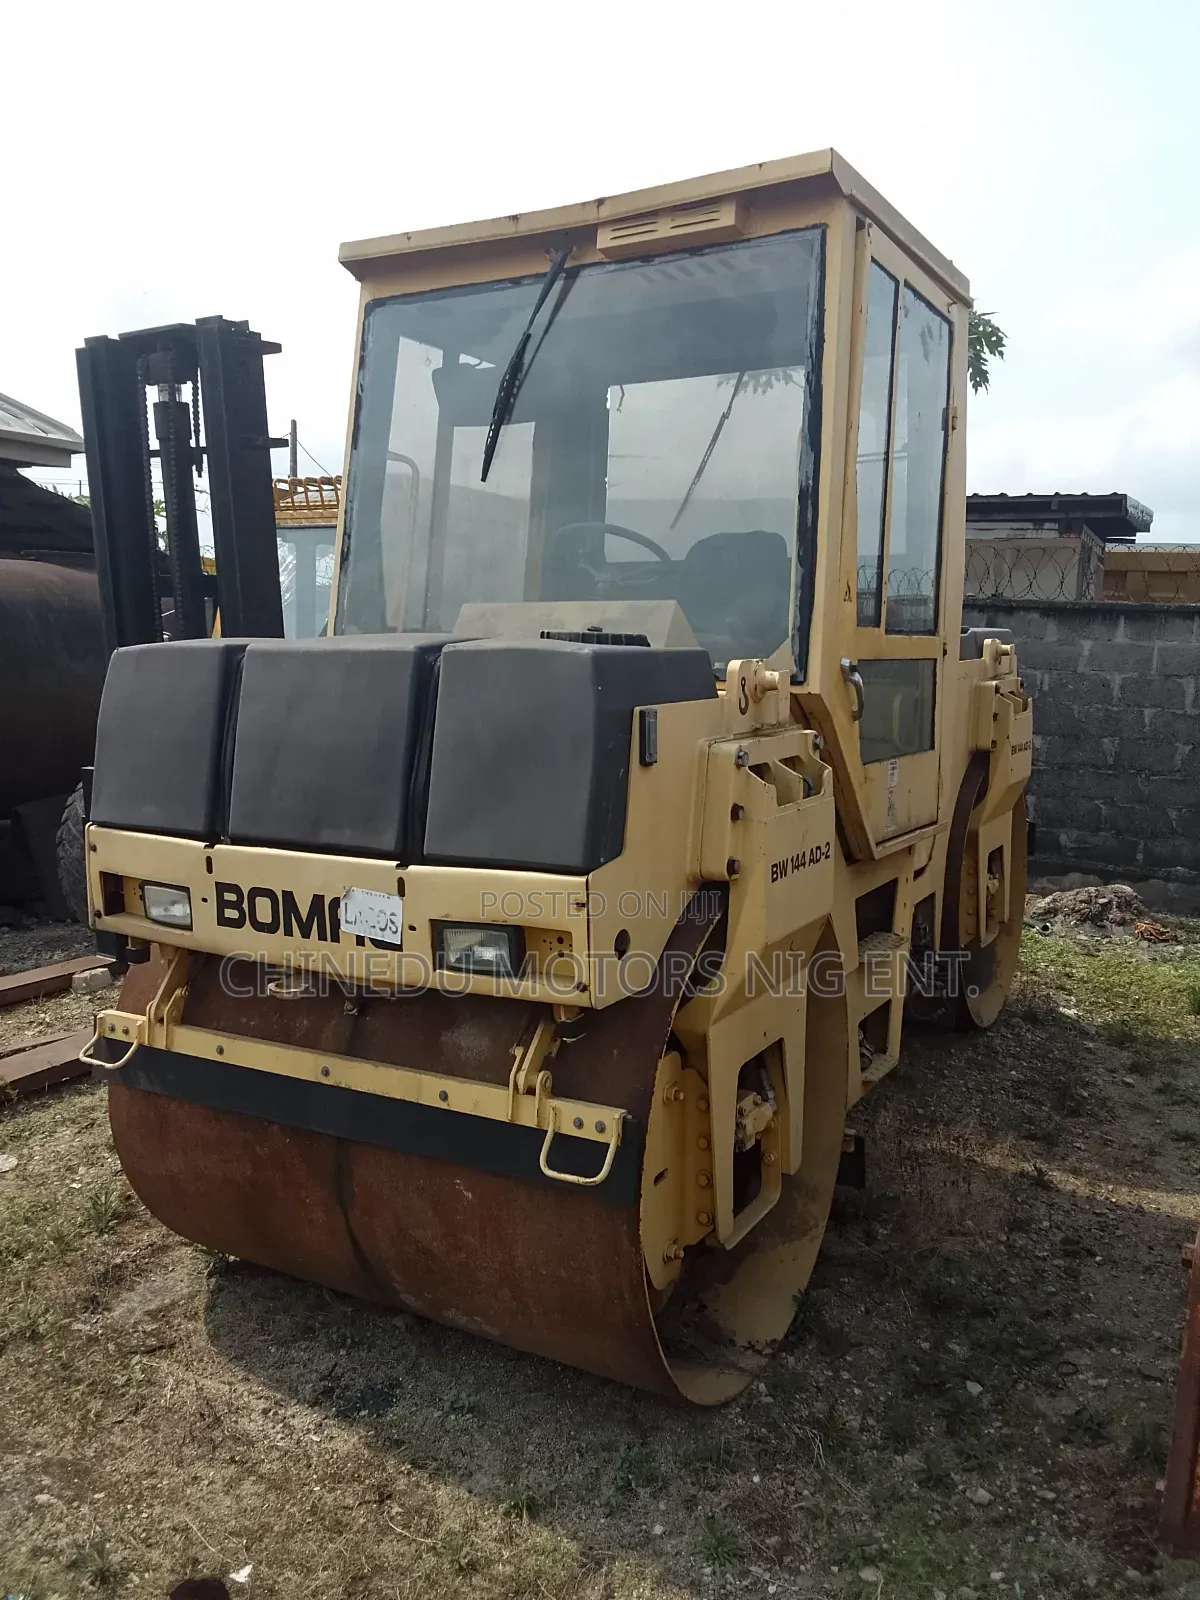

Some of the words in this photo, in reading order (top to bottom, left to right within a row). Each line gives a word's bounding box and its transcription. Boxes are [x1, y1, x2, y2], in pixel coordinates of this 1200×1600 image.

[771, 857, 788, 883] BW
[790, 850, 806, 874] 144
[808, 841, 831, 867] AD-2
[214, 881, 403, 952] BOMA
